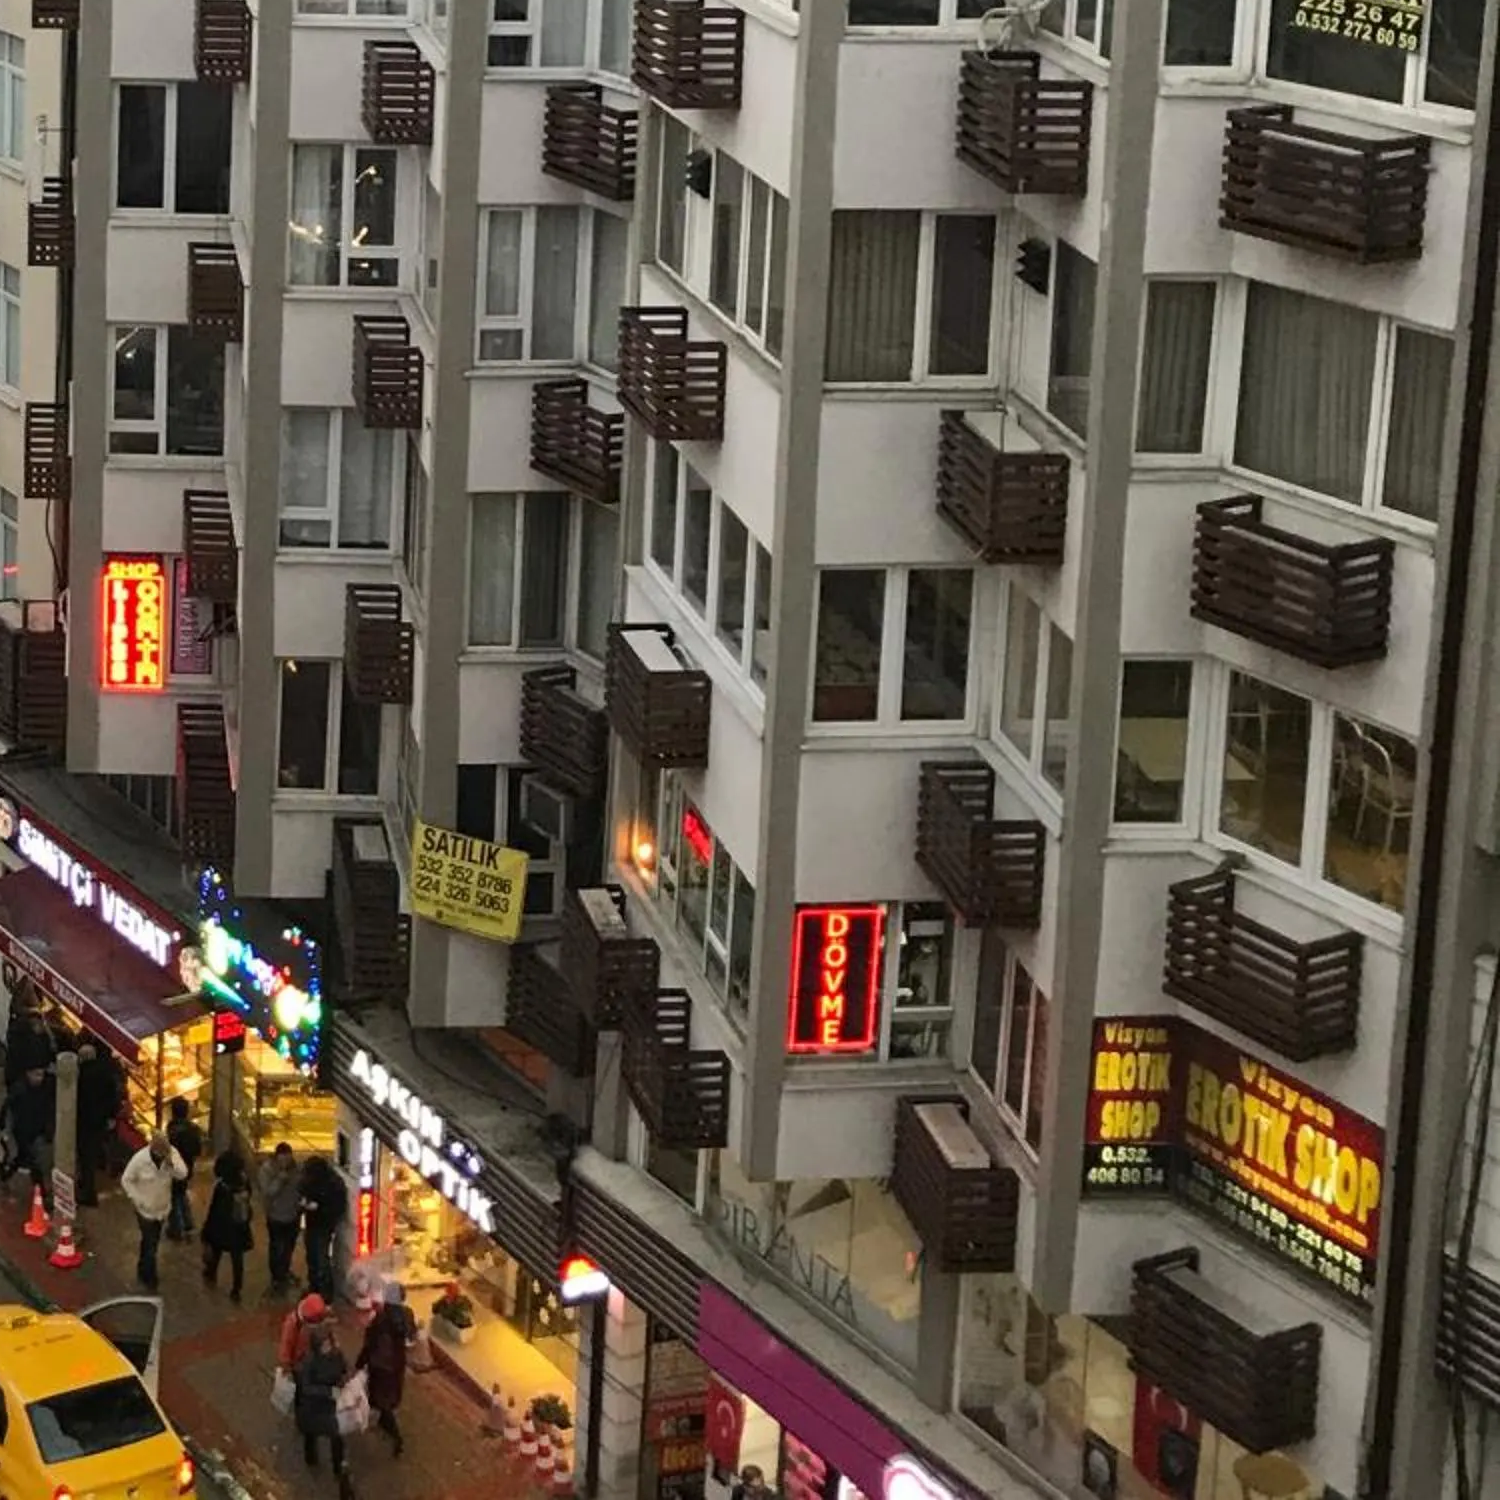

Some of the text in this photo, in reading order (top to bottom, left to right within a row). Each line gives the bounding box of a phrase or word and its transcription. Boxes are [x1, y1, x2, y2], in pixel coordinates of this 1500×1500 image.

[1343, 19, 1373, 41] 272
[1376, 27, 1395, 46] 60
[1398, 31, 1417, 51] 59
[1353, 3, 1383, 23] 26
[1390, 11, 1420, 31] 47
[422, 827, 501, 870] SATILIK
[418, 853, 443, 875] 532
[447, 863, 474, 885] 352
[100, 881, 173, 968] VEDAT
[1104, 1021, 1169, 1049] Vizyon
[1239, 1055, 1335, 1129] Vizyon
[1099, 1100, 1161, 1140] SHOP
[1087, 1167, 1118, 1184] 406
[1293, 1123, 1381, 1225] SHOP
